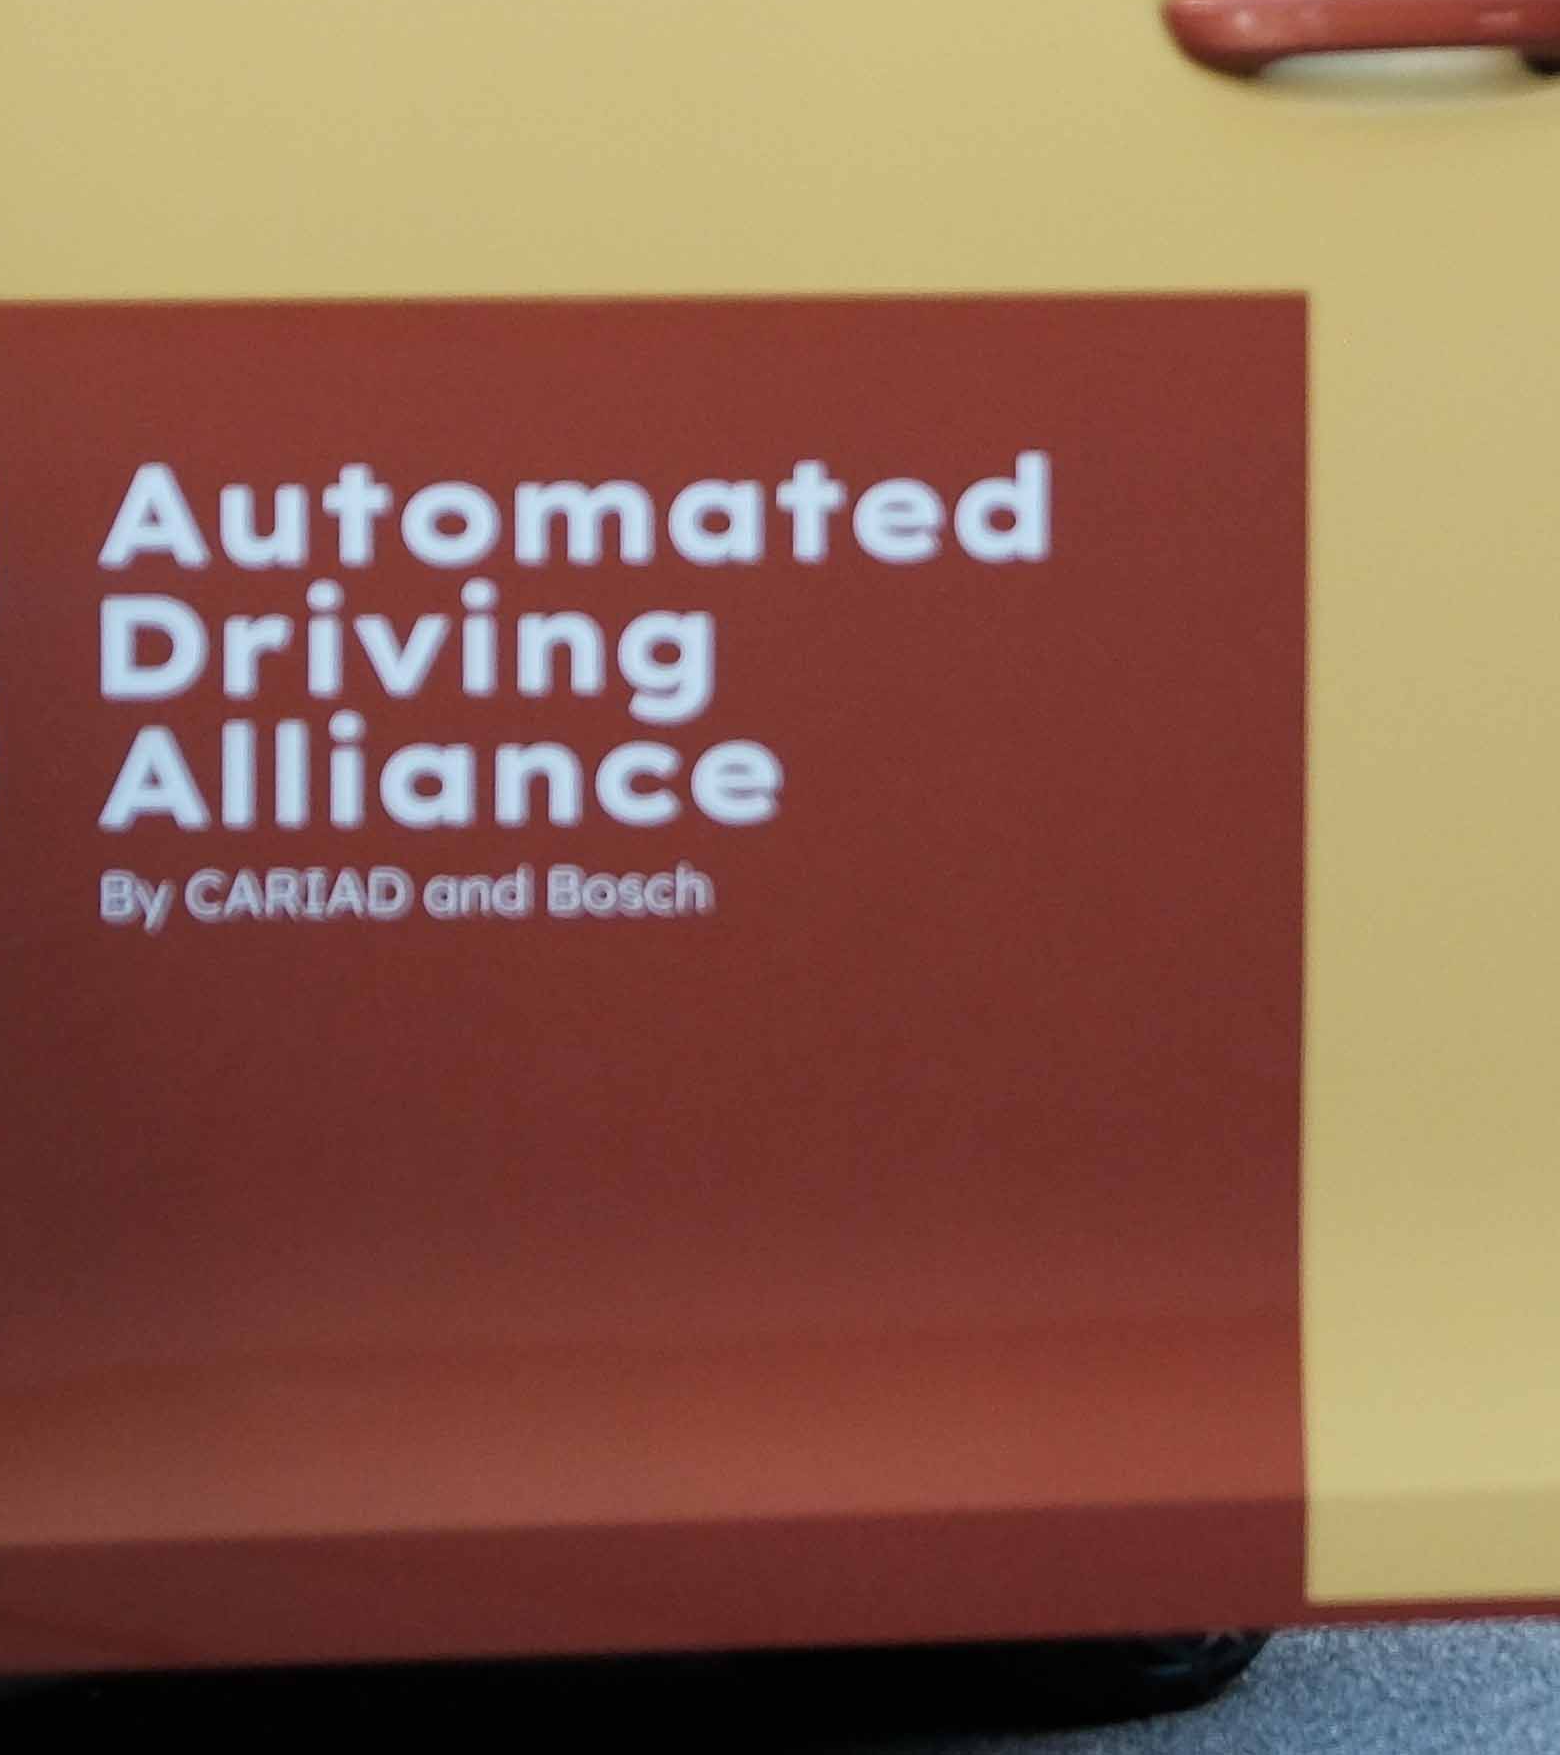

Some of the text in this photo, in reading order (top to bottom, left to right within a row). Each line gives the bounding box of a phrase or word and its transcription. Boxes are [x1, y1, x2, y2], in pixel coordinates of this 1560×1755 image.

[98, 450, 1051, 569] Automated
[99, 578, 716, 723] Driving
[97, 708, 784, 829] Alliance
[99, 861, 716, 932] By CARIAD and Bosch
